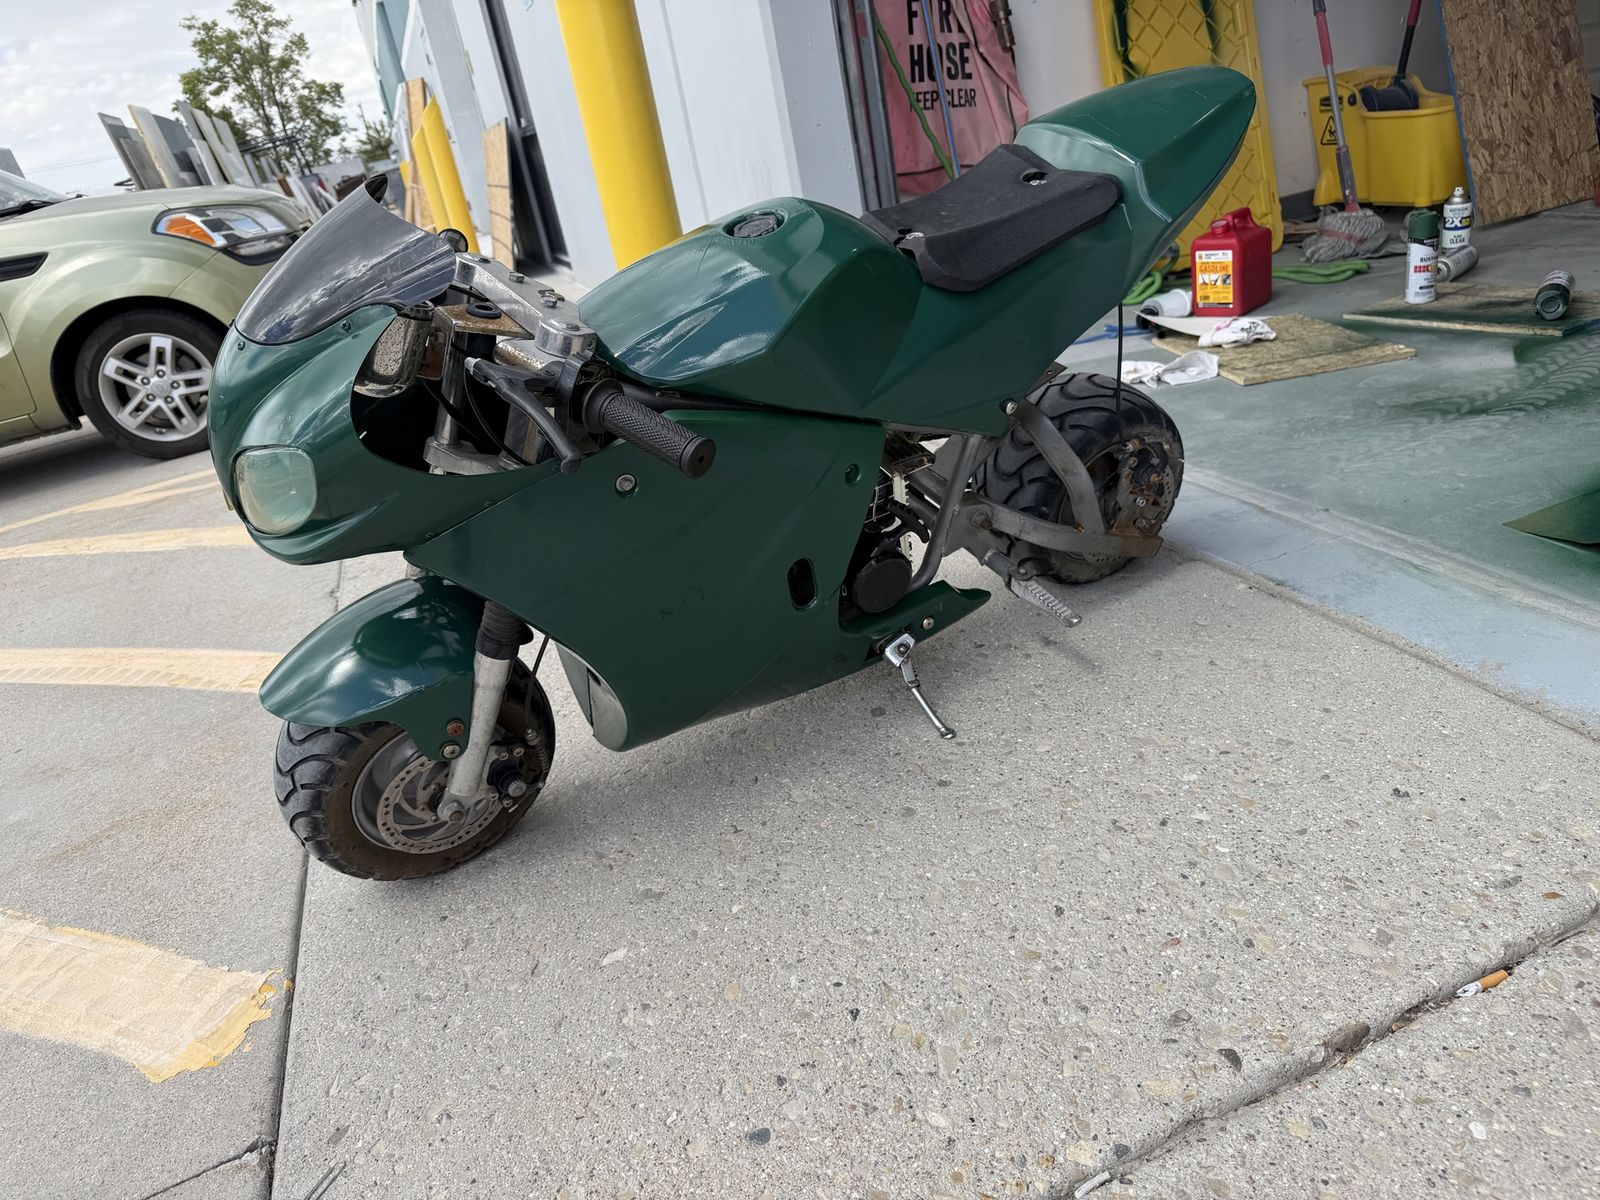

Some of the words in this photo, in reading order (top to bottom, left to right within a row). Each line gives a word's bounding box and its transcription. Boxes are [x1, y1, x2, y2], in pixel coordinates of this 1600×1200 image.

[907, 0, 966, 35] FR
[909, 42, 973, 83] HOSE
[910, 91, 940, 112] EEP
[1445, 216, 1461, 228] 2X
[1199, 263, 1230, 273] GASOLINE
